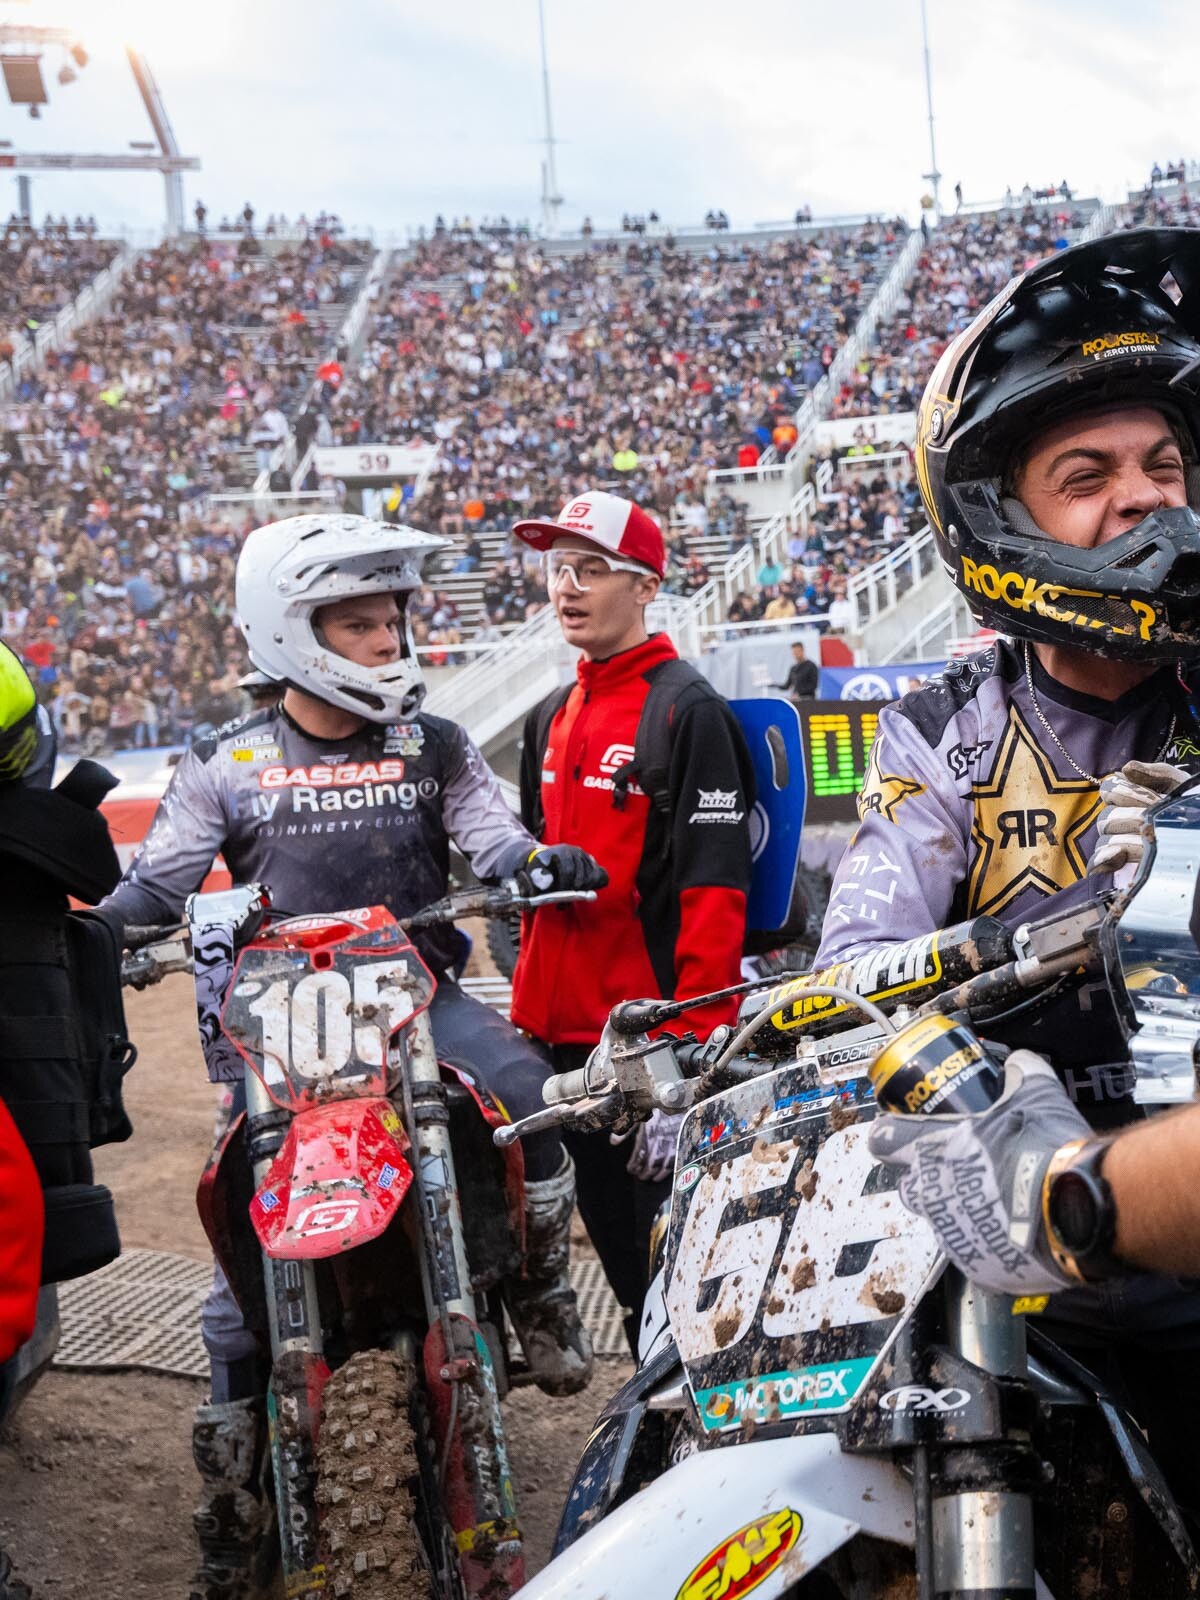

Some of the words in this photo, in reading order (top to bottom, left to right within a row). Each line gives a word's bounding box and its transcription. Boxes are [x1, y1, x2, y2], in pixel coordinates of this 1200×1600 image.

[1082, 331, 1161, 357] ROCKSTAR
[1130, 342, 1158, 354] DRINK
[359, 452, 391, 472] 39
[262, 762, 402, 788] GASGAS
[293, 778, 417, 815] Racing
[249, 959, 415, 1086] 105
[775, 1100, 824, 1120] FUTRES
[923, 1076, 964, 1114] ENERGY
[950, 1148, 1030, 1281] Mechanix
[678, 1506, 794, 1600] FMF
